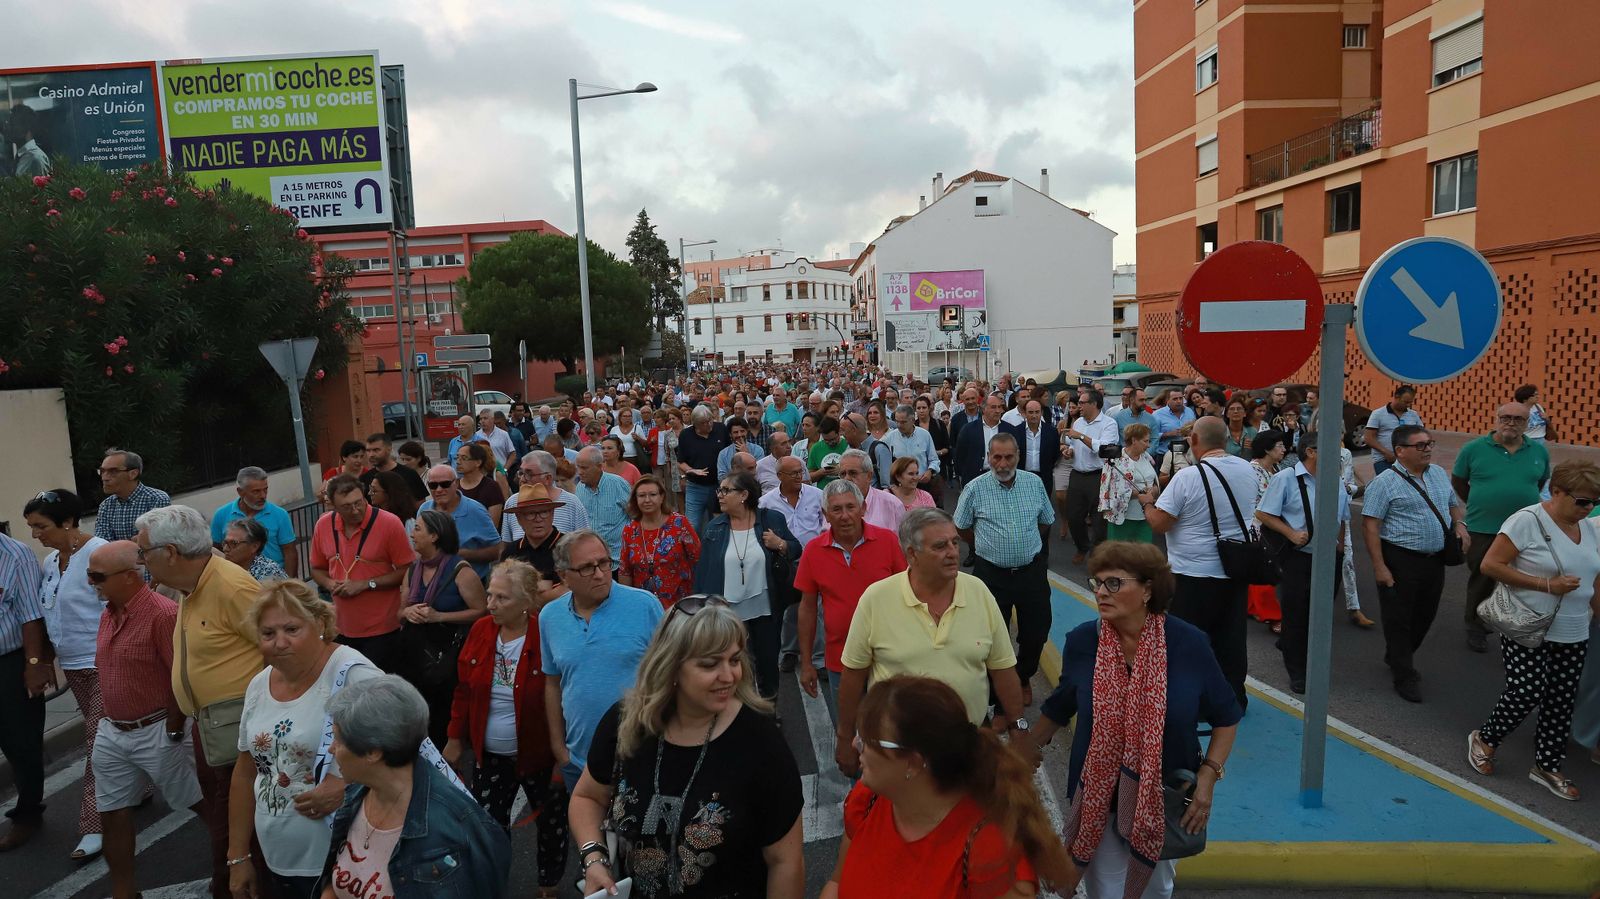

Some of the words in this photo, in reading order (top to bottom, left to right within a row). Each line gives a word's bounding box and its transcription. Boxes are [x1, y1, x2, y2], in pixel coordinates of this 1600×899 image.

[168, 62, 374, 96] vendermicoche.es
[38, 86, 85, 99] Casino
[87, 80, 143, 97] Admiral
[84, 105, 100, 115] es
[103, 100, 145, 115] Unión
[173, 95, 287, 115] COMPRAMOS
[289, 94, 311, 109] TU
[315, 90, 374, 108] COCHE
[231, 115, 255, 130] EN
[259, 113, 280, 128] 30
[284, 112, 318, 127] MIN
[112, 129, 145, 137] Congresos
[91, 145, 113, 153] Menús
[113, 144, 146, 153] especiales
[181, 141, 245, 168] NADIE
[253, 138, 314, 164] PAGA
[320, 129, 367, 161] MÁS
[83, 154, 108, 162] Eventos
[118, 153, 146, 161] Empresa
[282, 183, 290, 192] A
[291, 182, 303, 191] 15
[305, 180, 343, 190] METROS
[280, 194, 292, 202] EN
[294, 193, 306, 202] EL
[307, 190, 348, 201] PARKING
[288, 203, 343, 219] RENFE
[889, 273, 903, 281] A-7
[886, 285, 908, 295] 113B
[936, 287, 979, 300] BriCor
[944, 308, 956, 321] P
[416, 355, 424, 367] P
